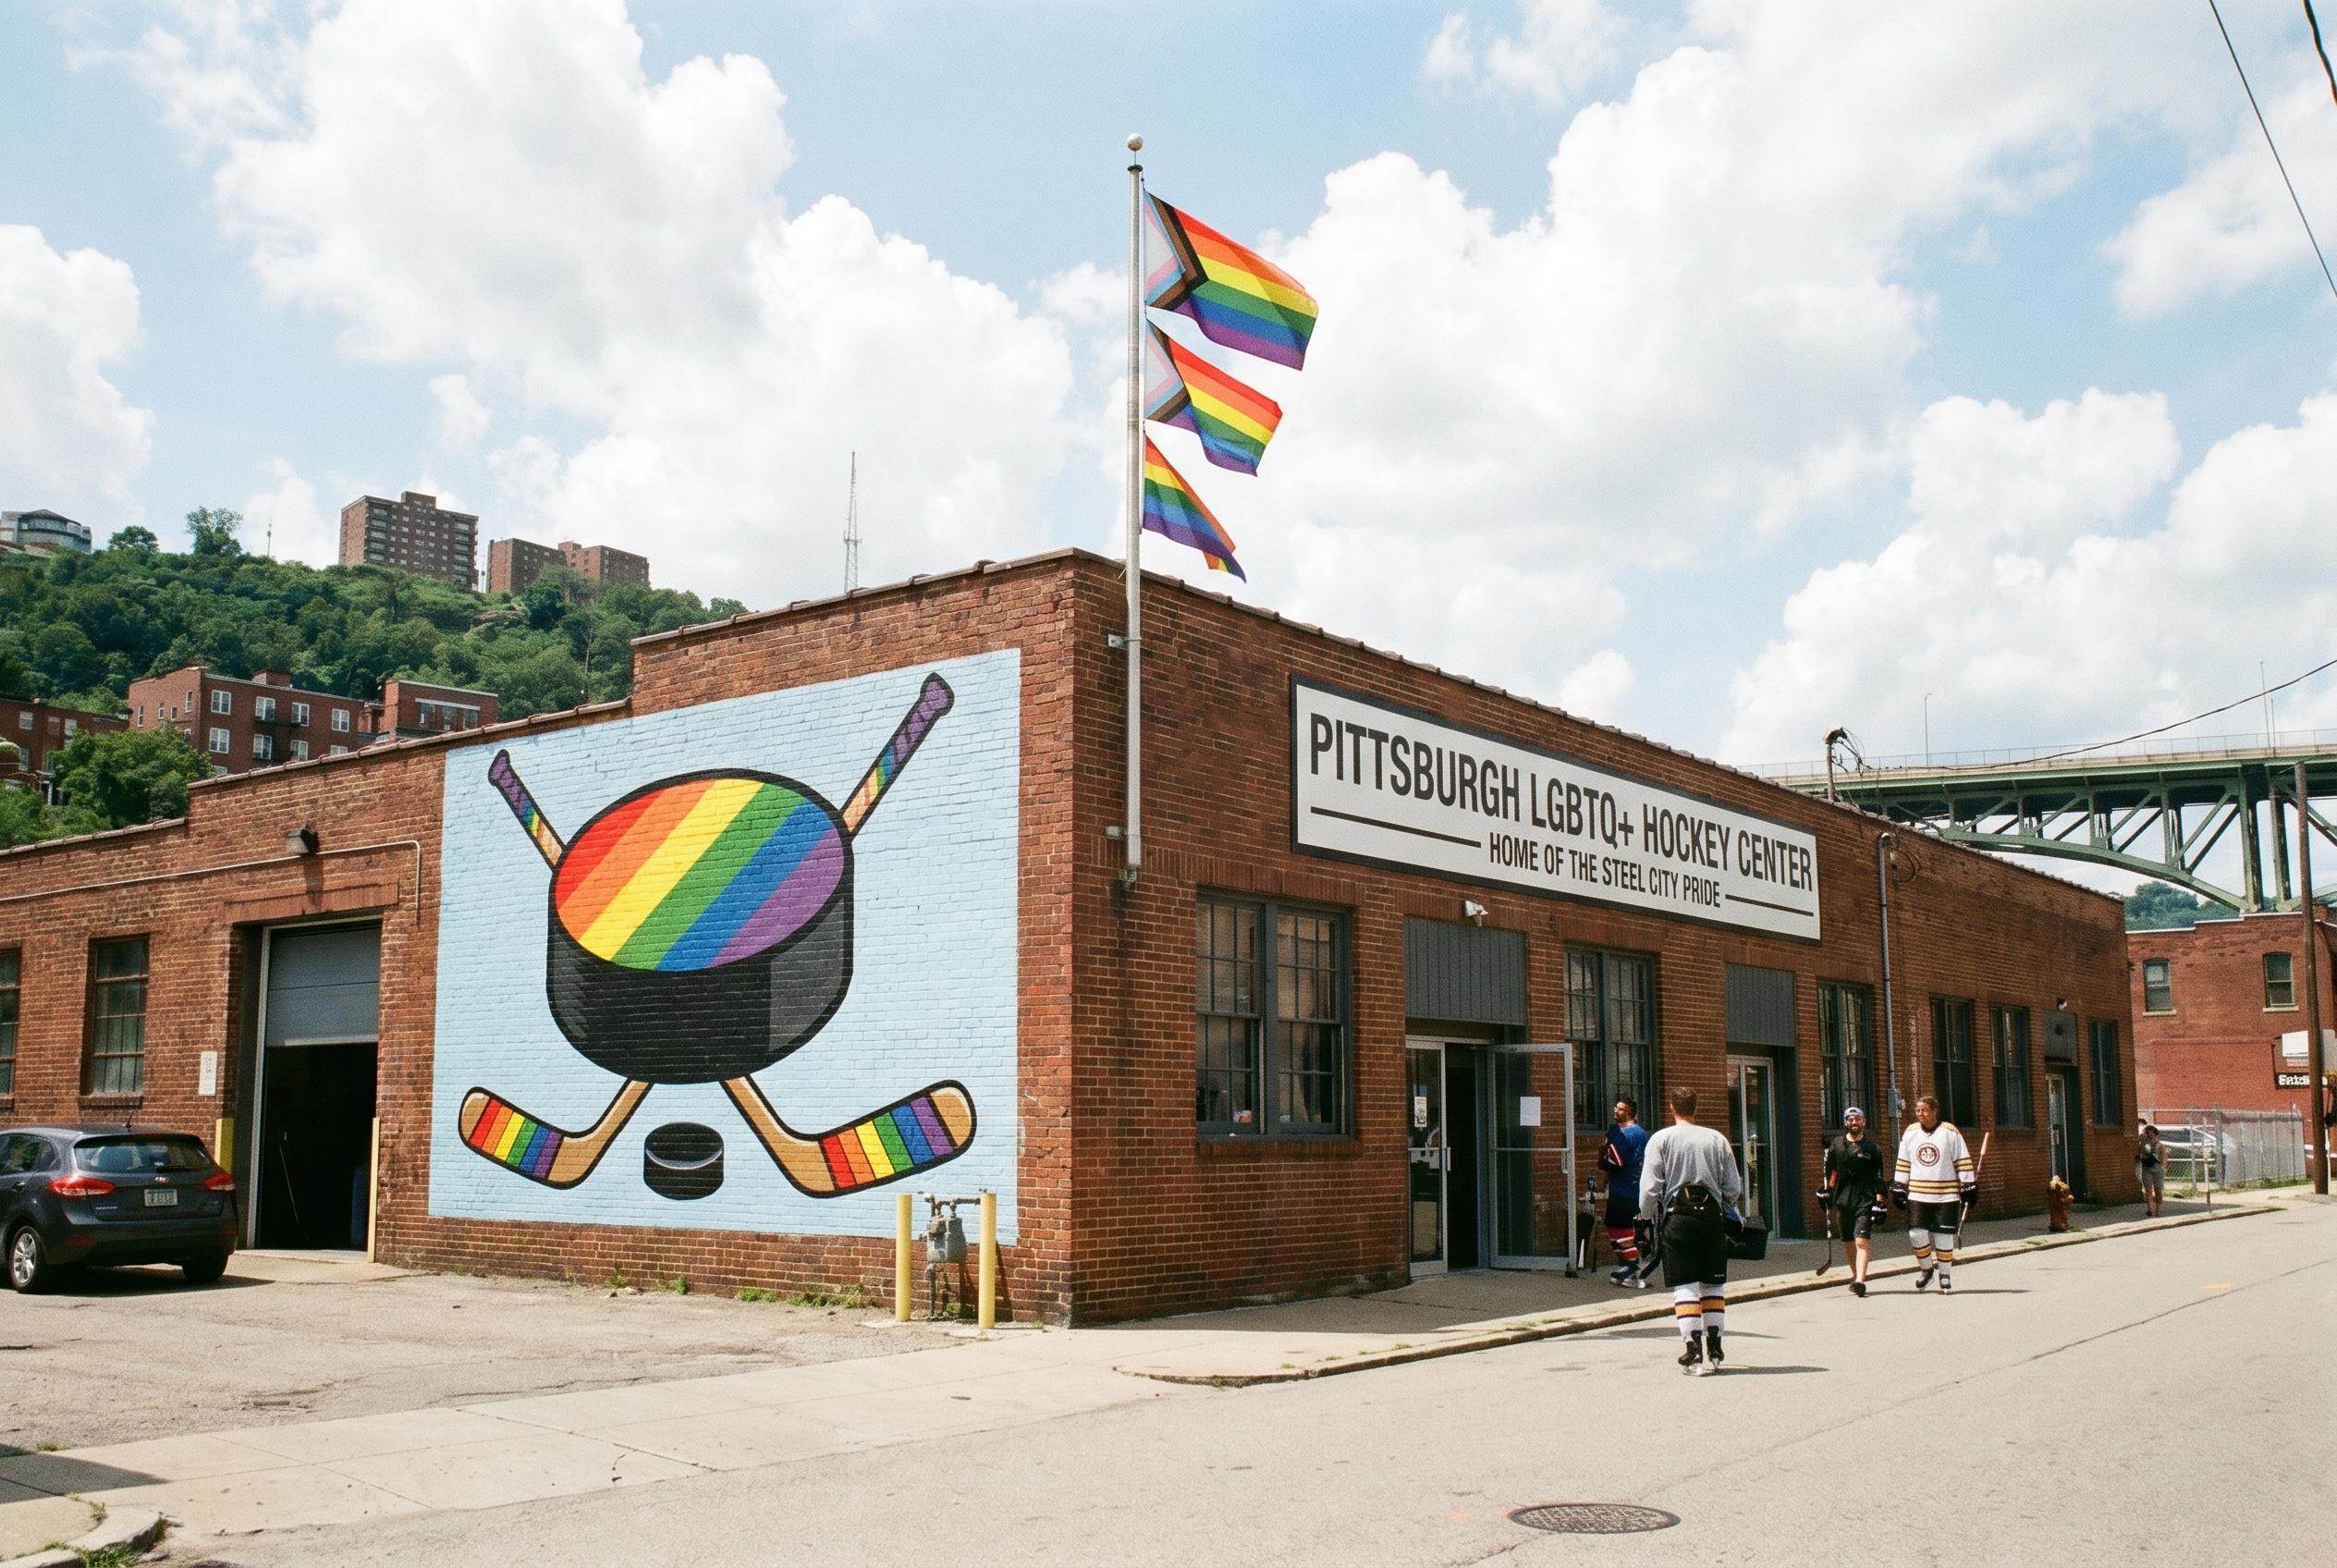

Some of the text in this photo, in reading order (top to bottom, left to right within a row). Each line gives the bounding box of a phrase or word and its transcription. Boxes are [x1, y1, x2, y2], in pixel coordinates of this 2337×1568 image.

[1310, 712, 1813, 892] PITTSBURGH LGBTQ+ HOCKEY CENTER
[1489, 831, 1721, 909] HOME OF THE STEEL CITY PRIDE
